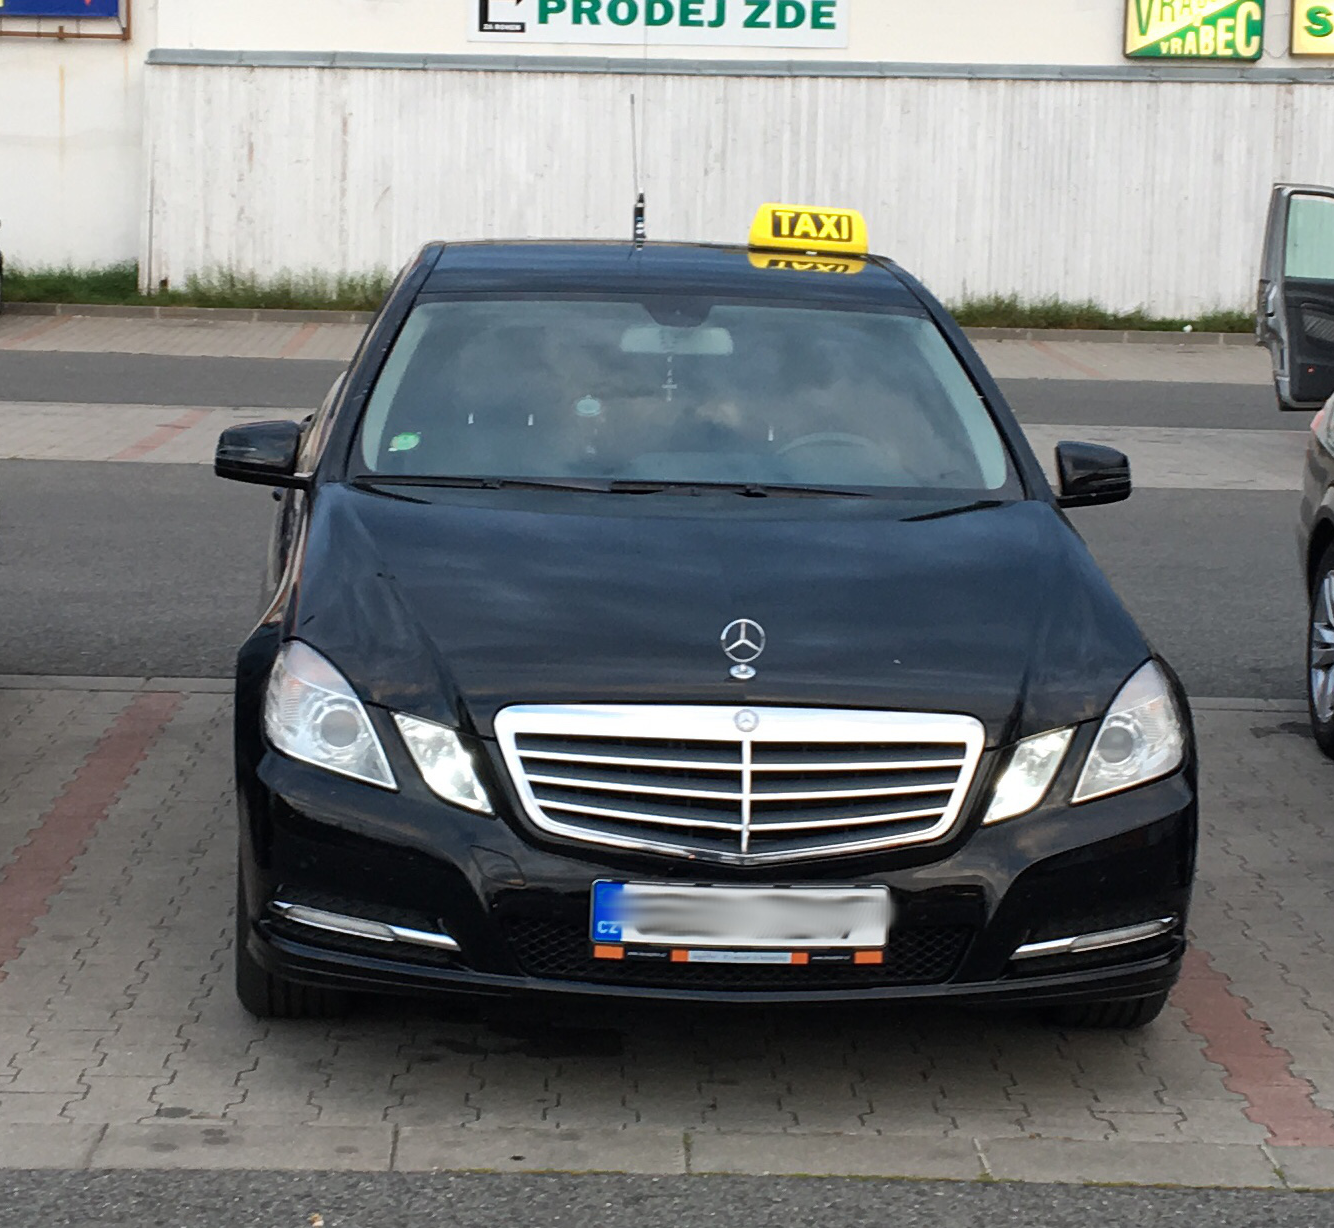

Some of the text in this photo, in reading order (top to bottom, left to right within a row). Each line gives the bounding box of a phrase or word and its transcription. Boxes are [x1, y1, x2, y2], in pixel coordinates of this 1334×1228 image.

[537, 0, 838, 30] PRODEJ ZDE
[1160, 1, 1261, 57] VRABEC
[775, 211, 849, 240] TAXI
[597, 920, 619, 934] CZ
